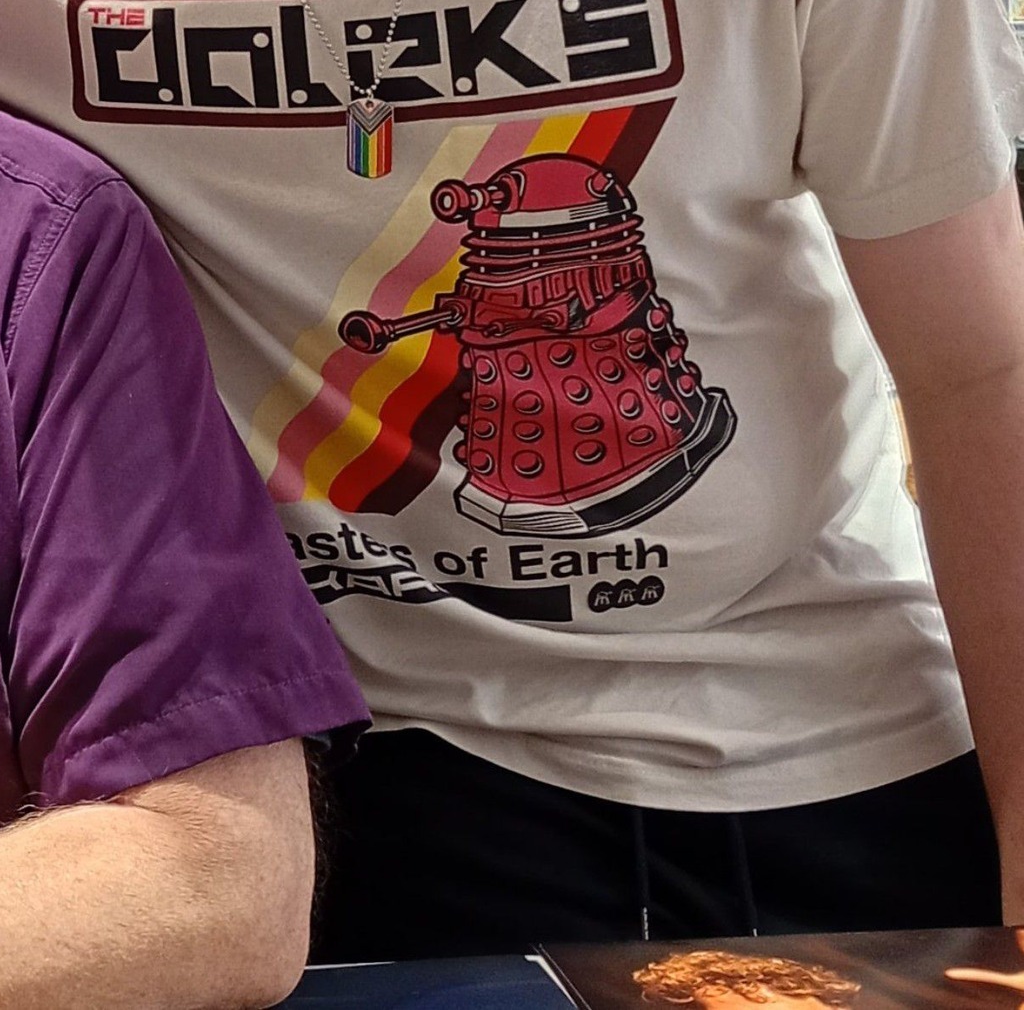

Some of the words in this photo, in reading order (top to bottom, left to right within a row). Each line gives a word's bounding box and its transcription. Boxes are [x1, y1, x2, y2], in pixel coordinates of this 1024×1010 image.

[87, 7, 146, 27] THE
[433, 546, 488, 580] of
[508, 537, 669, 581] Earth
